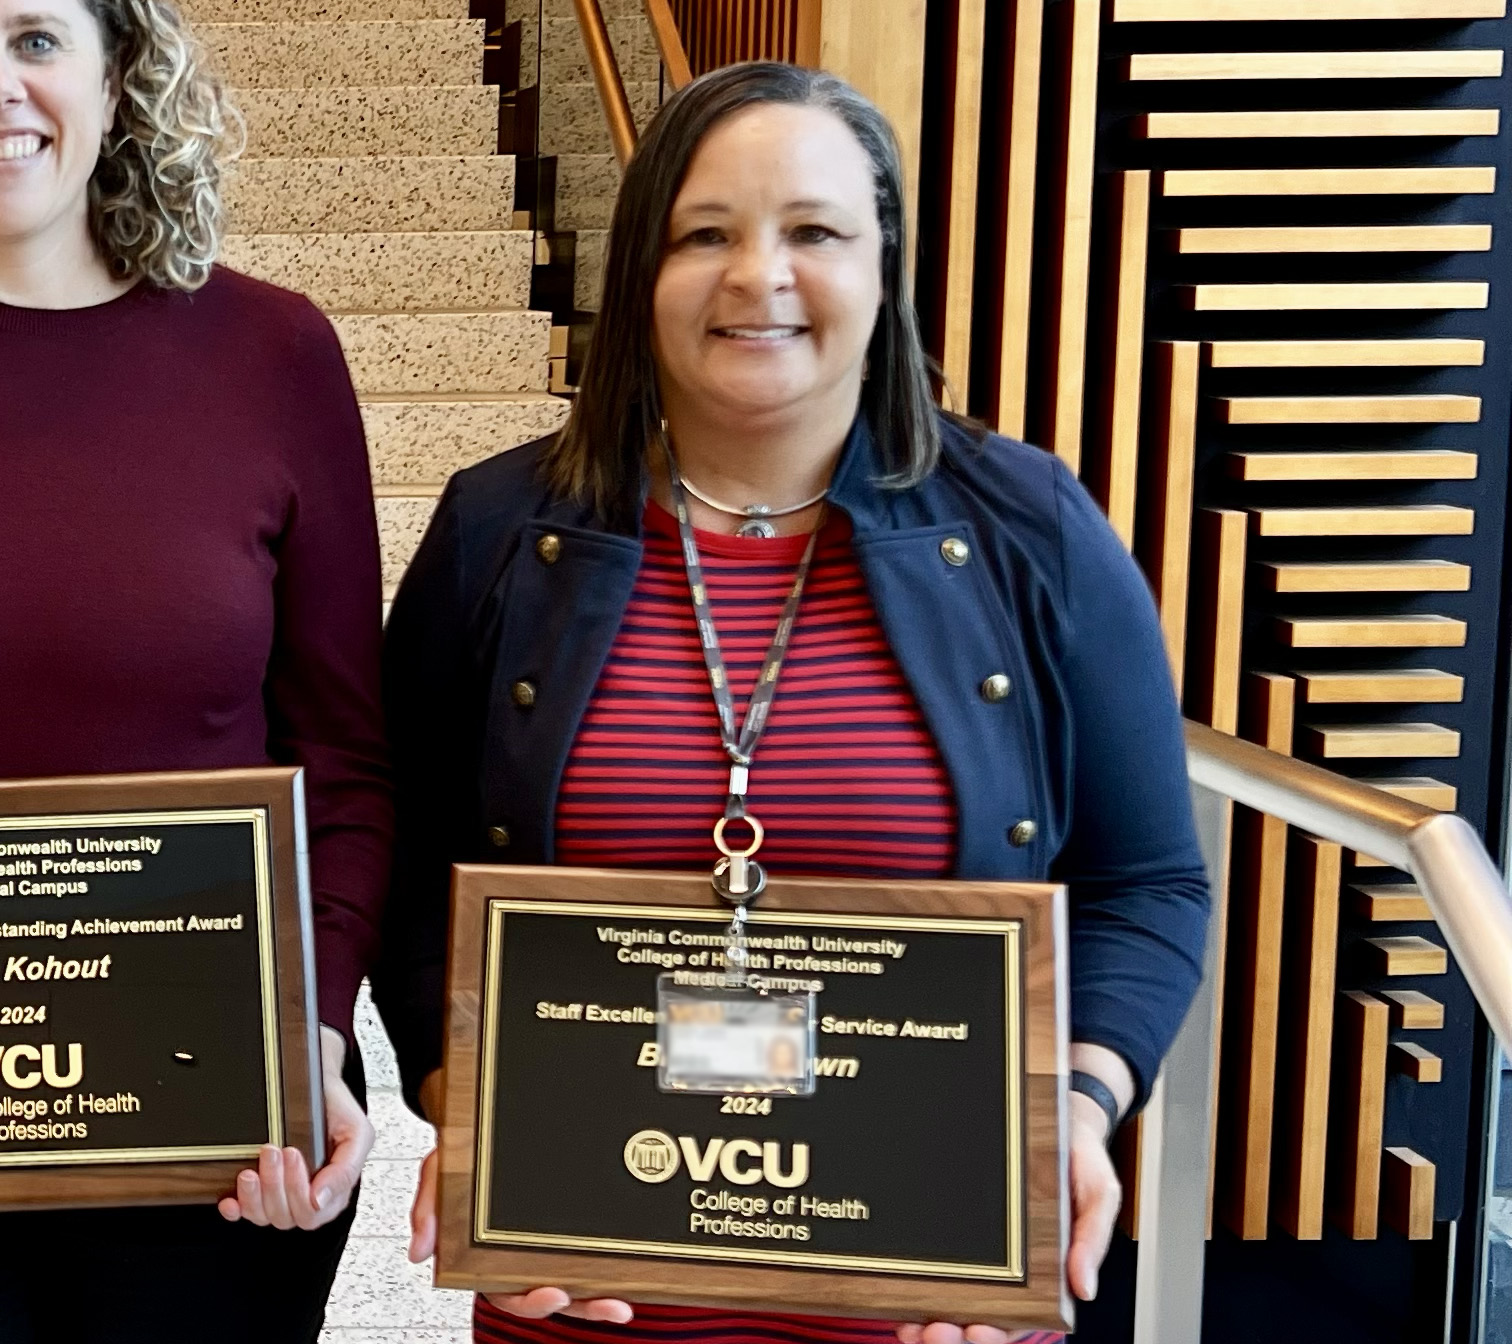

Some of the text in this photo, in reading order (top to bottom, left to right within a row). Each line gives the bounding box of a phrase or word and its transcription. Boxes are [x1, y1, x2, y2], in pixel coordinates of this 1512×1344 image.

[76, 835, 162, 855] University
[41, 857, 143, 875] Professions
[18, 879, 88, 898] Campus
[70, 916, 184, 935] Achievement
[186, 913, 243, 931] Award
[596, 927, 906, 959] Virginia Commonwealth University
[3, 954, 112, 982] Kohout
[617, 947, 686, 969] College
[688, 951, 709, 966] of
[773, 954, 884, 975] Professions
[0, 1005, 46, 1025] 2024
[535, 1001, 584, 1020] Staff
[820, 1016, 898, 1037] Service
[899, 1020, 968, 1040] Award
[53, 1093, 73, 1115] of
[78, 1091, 141, 1114] Health
[720, 1095, 772, 1116] 2024
[678, 1136, 809, 1188] VCU
[690, 1188, 869, 1220] College of Health
[690, 1212, 811, 1241] Professions
